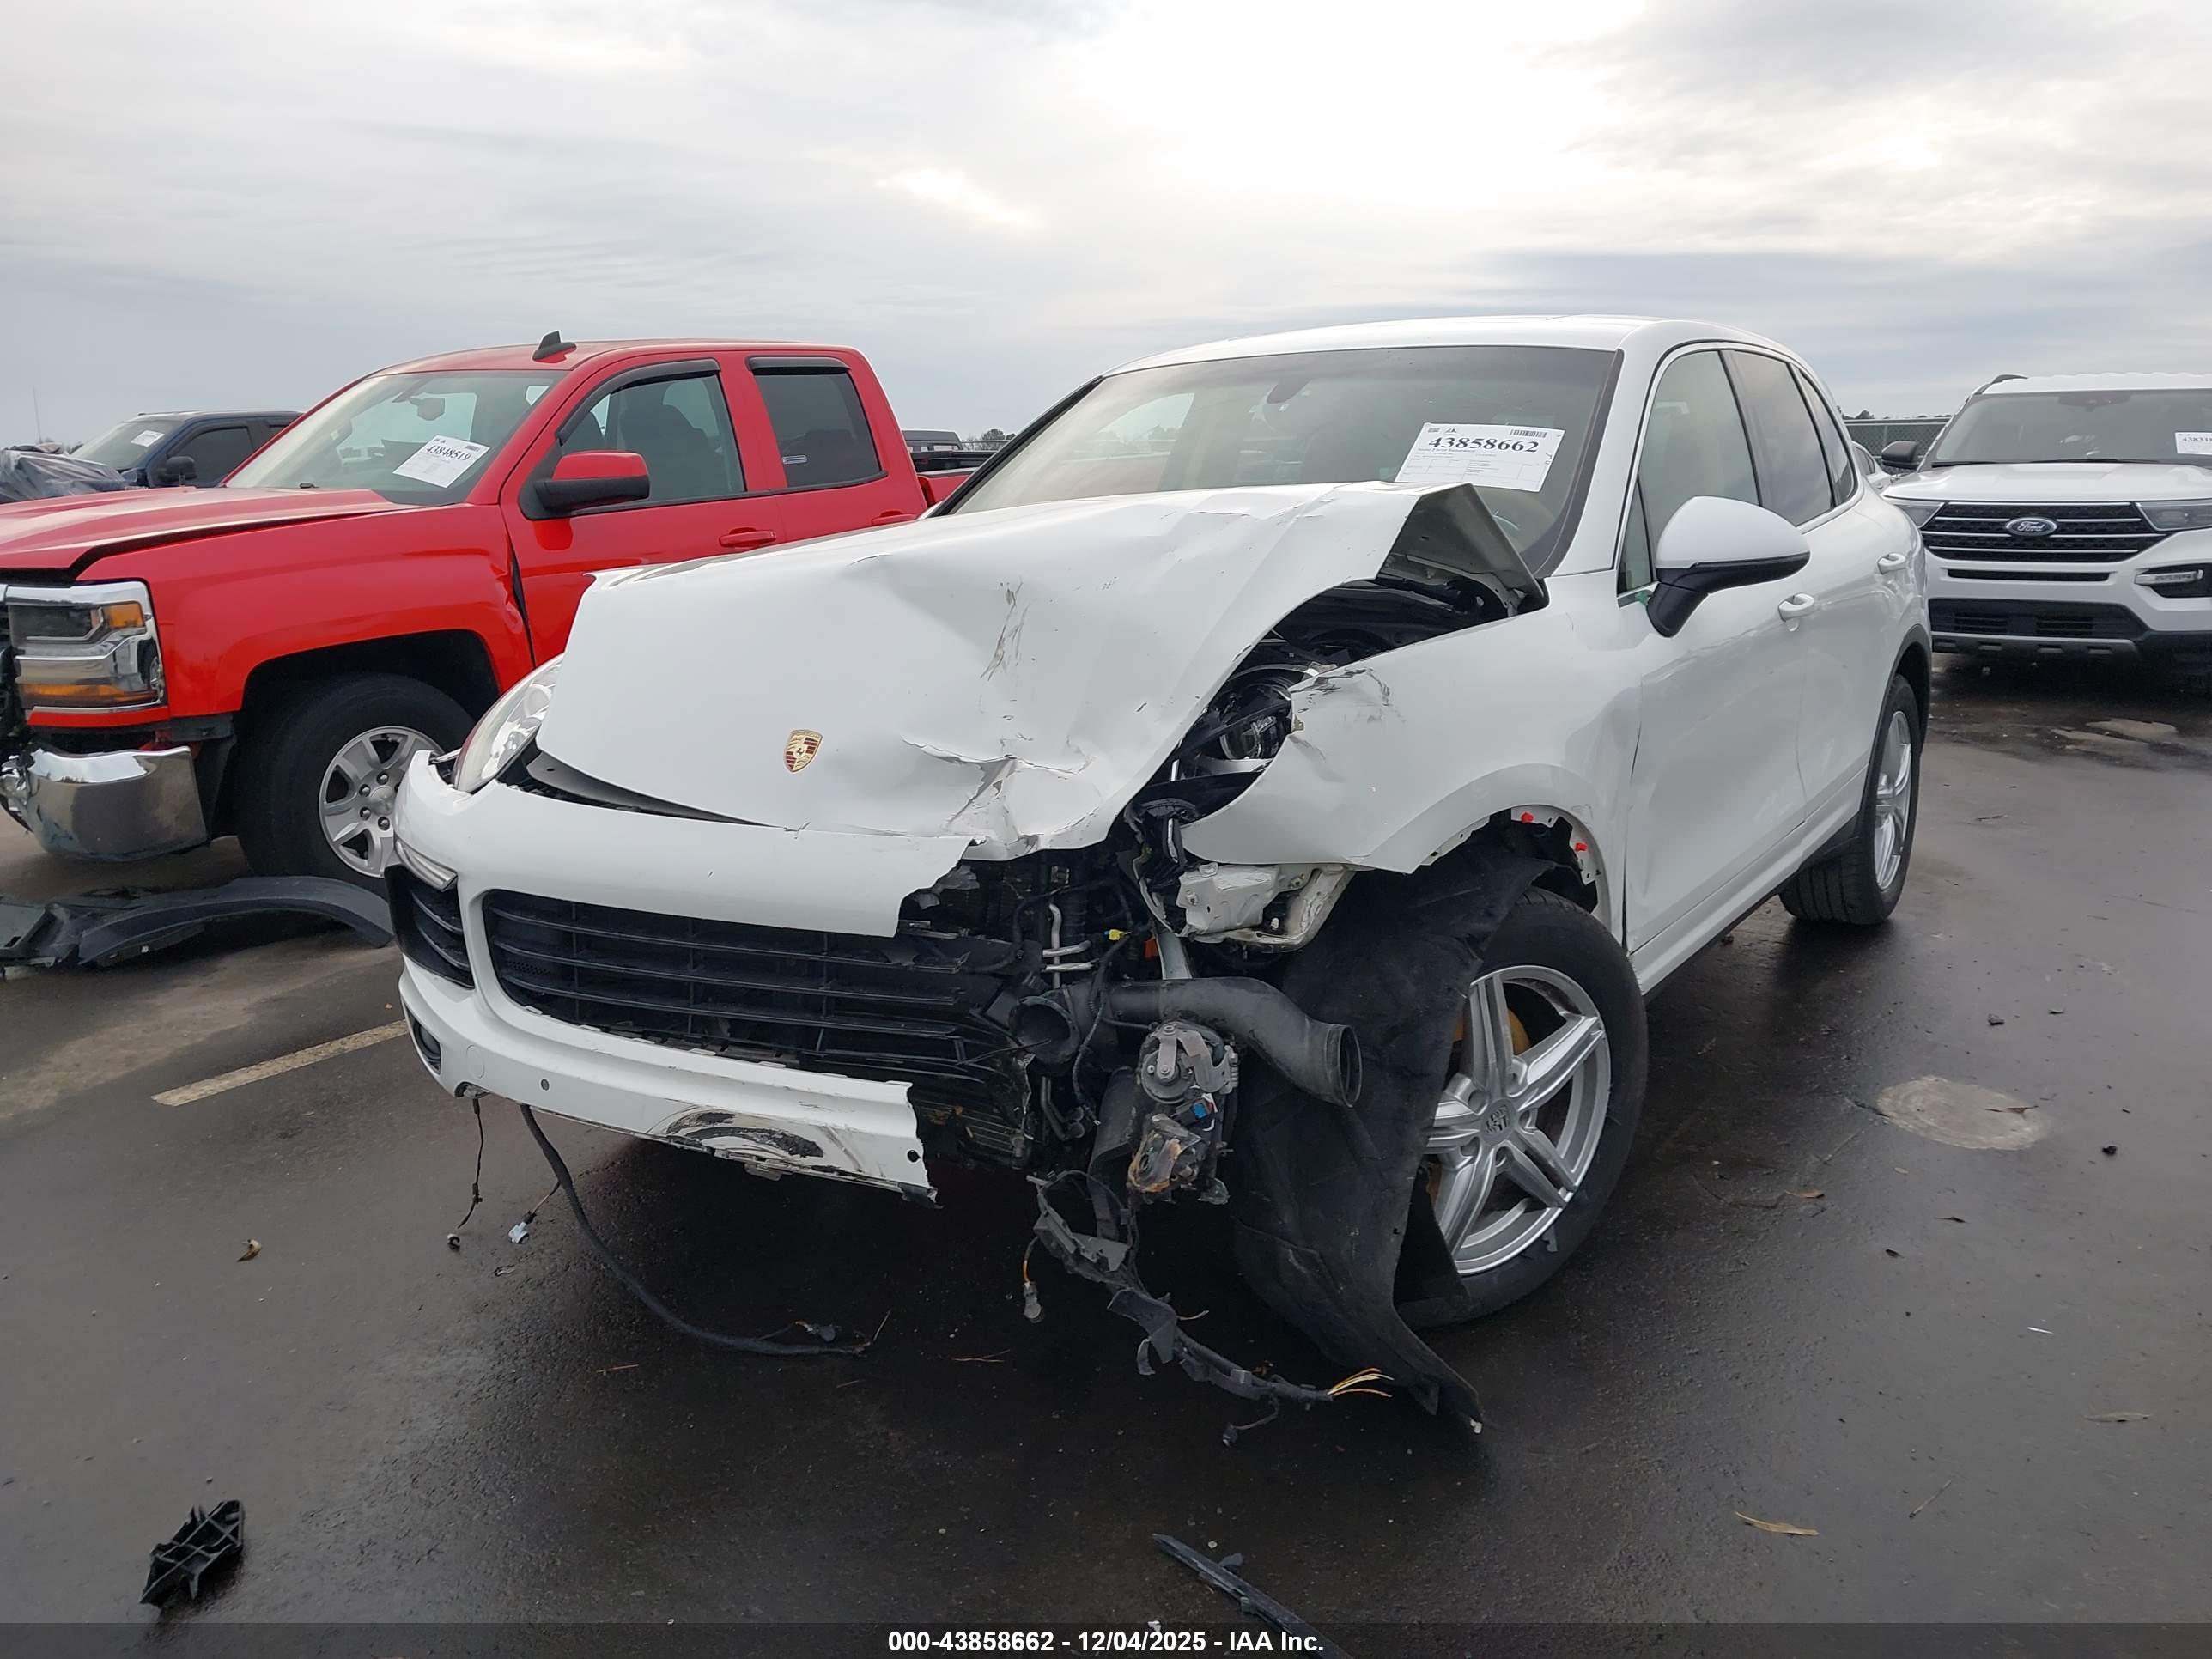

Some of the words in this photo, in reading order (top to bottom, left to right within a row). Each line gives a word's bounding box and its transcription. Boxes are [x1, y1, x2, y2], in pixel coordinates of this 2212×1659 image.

[426, 445, 471, 460] 43848519
[1428, 437, 1539, 453] 43858662
[2017, 521, 2045, 531] Ford
